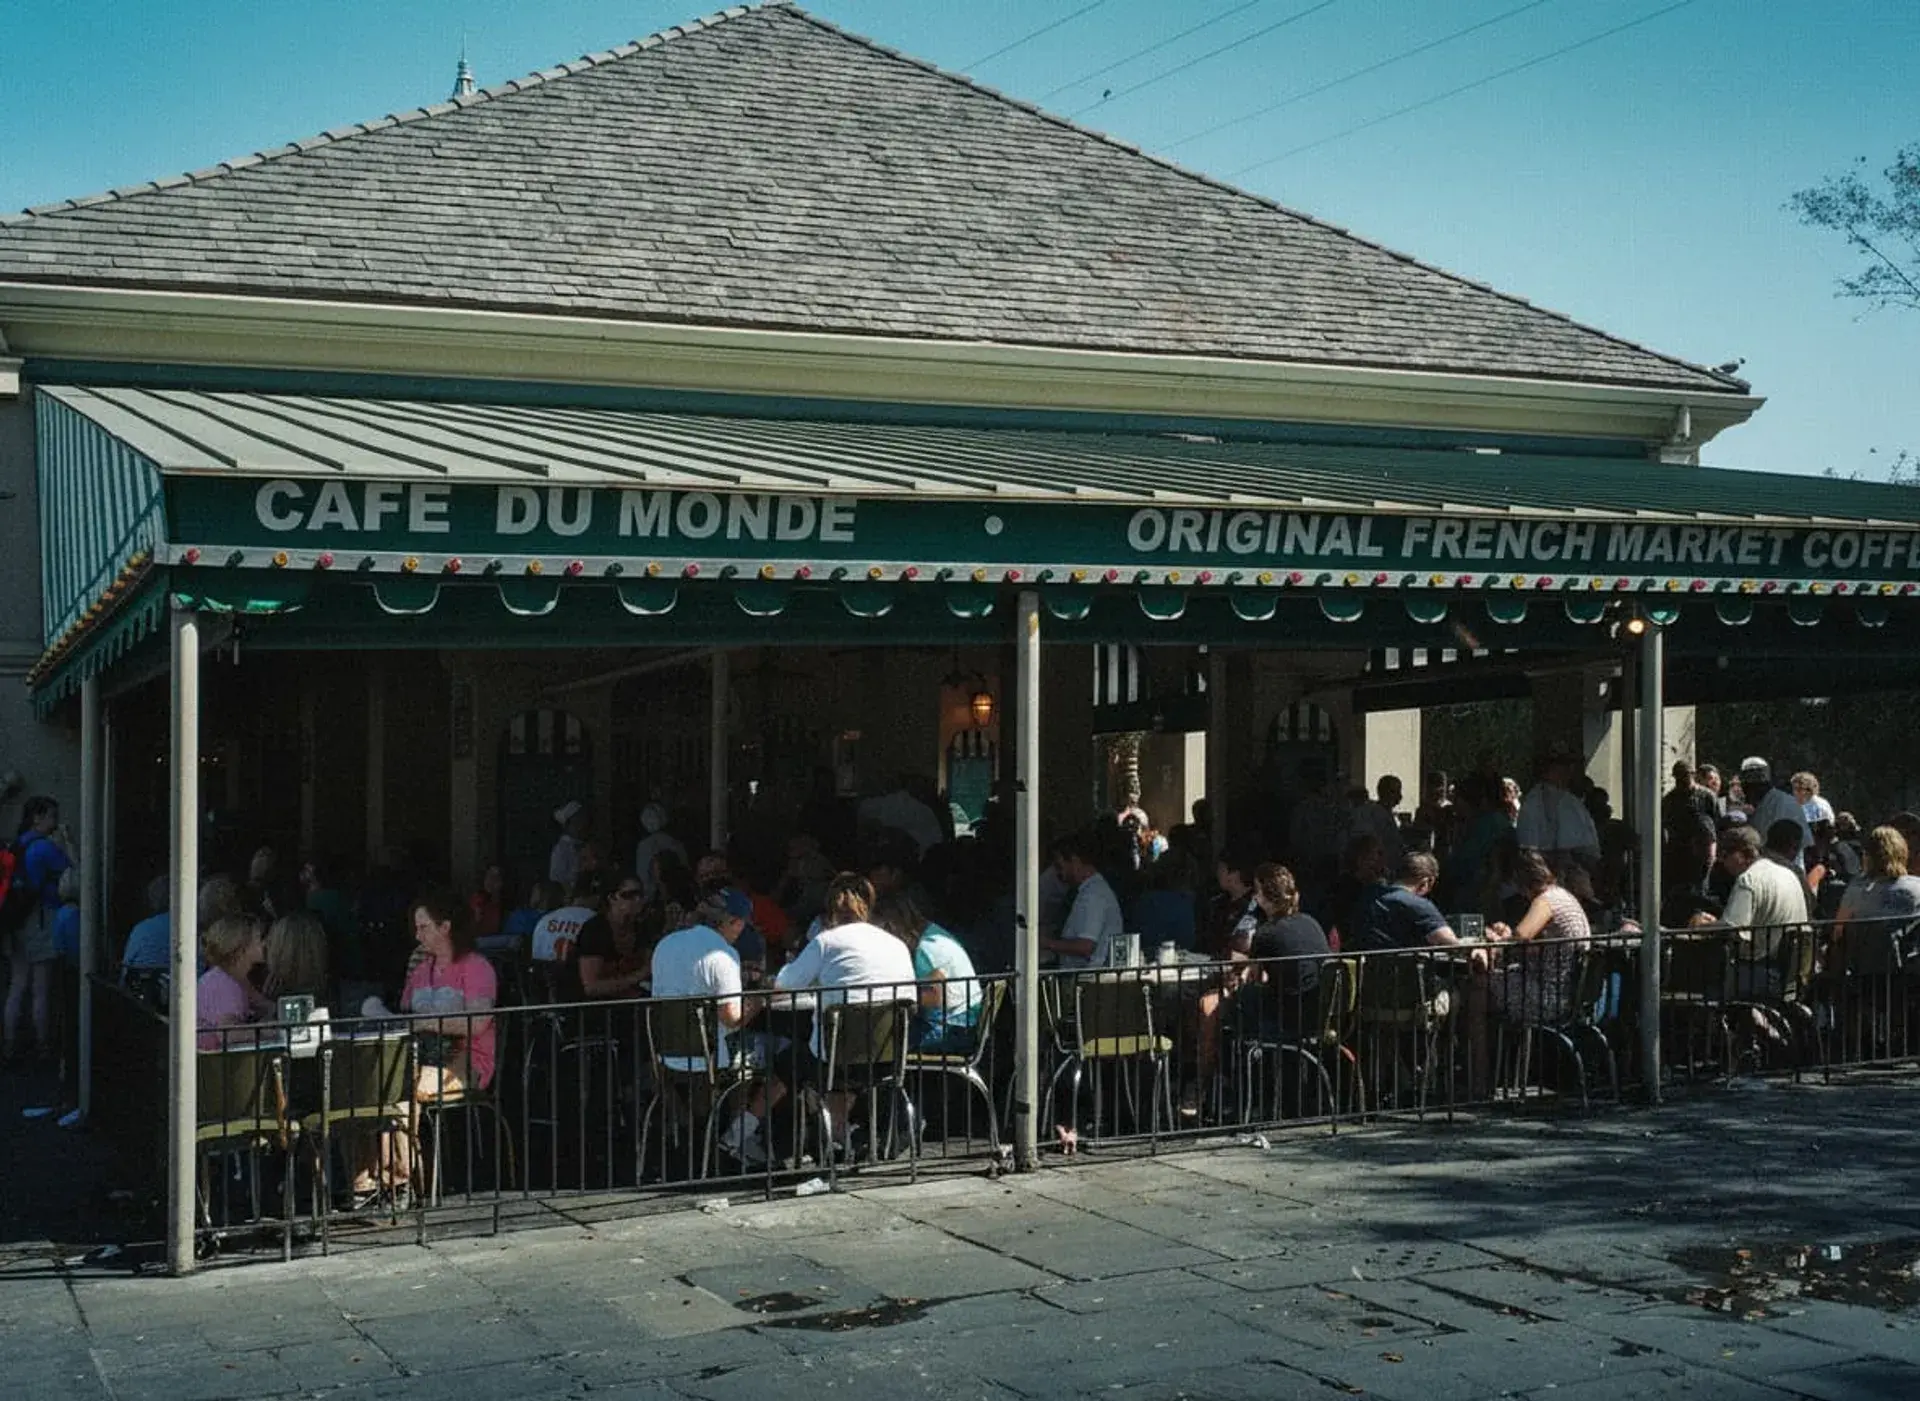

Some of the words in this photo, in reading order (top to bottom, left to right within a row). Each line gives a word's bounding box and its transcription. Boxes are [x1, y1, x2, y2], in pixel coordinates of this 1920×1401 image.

[255, 480, 451, 533] CAFE
[496, 486, 593, 536] DU
[618, 490, 857, 542] MONDE
[1127, 508, 1383, 557] ORIGINAL
[1401, 518, 1597, 561] FRENCH
[1606, 523, 1796, 566] MARKET
